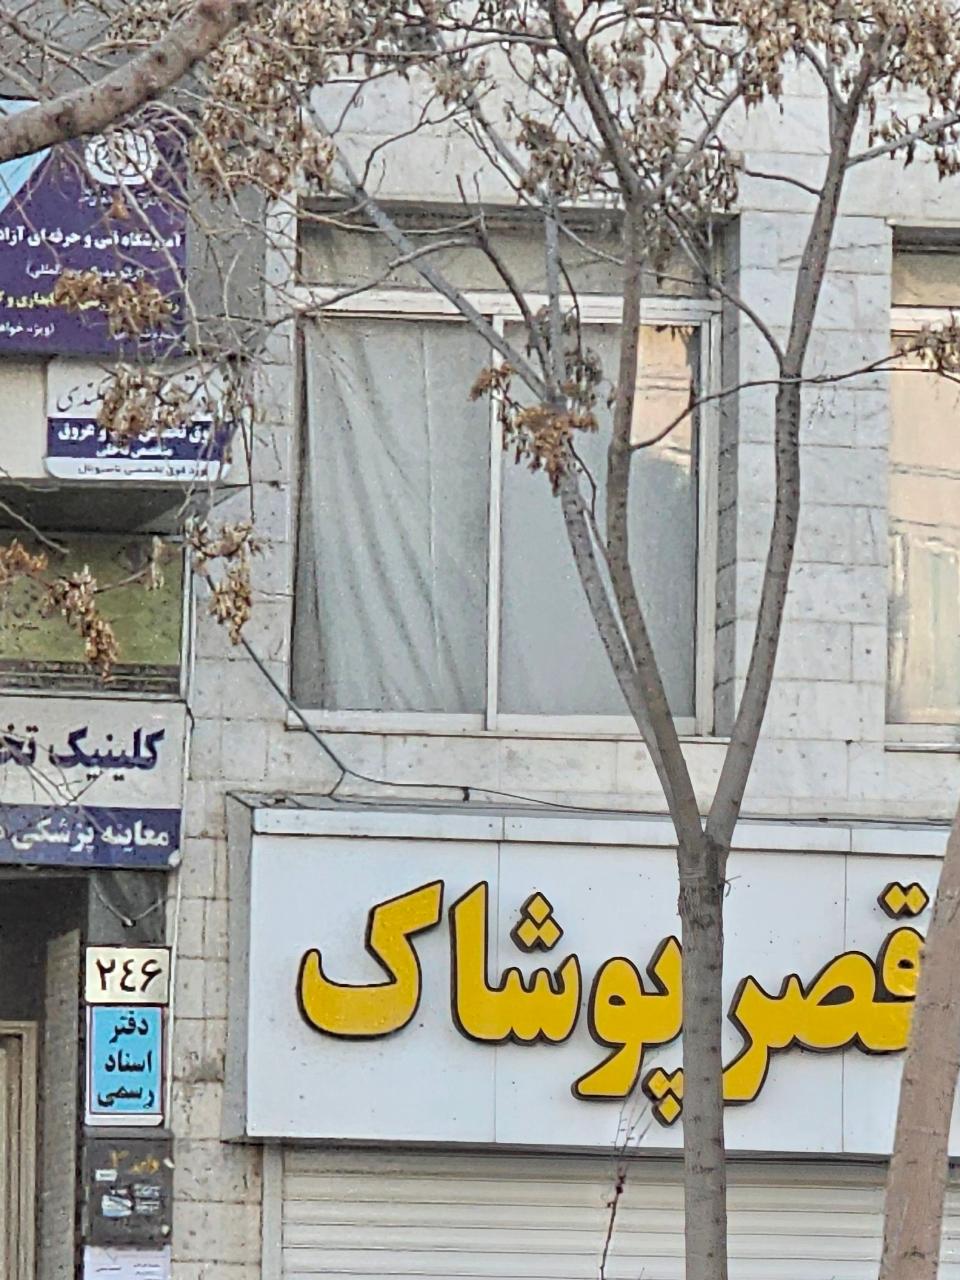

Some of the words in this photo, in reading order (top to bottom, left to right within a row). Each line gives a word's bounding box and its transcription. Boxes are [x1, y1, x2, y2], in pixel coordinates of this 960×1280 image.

[48, 726, 166, 782] کلینیک
[11, 817, 95, 852] پزشکی
[100, 820, 170, 853] معاینه
[108, 1010, 149, 1044] دفتر
[104, 1050, 153, 1073] اسناد
[97, 1086, 155, 1108] رسمی
